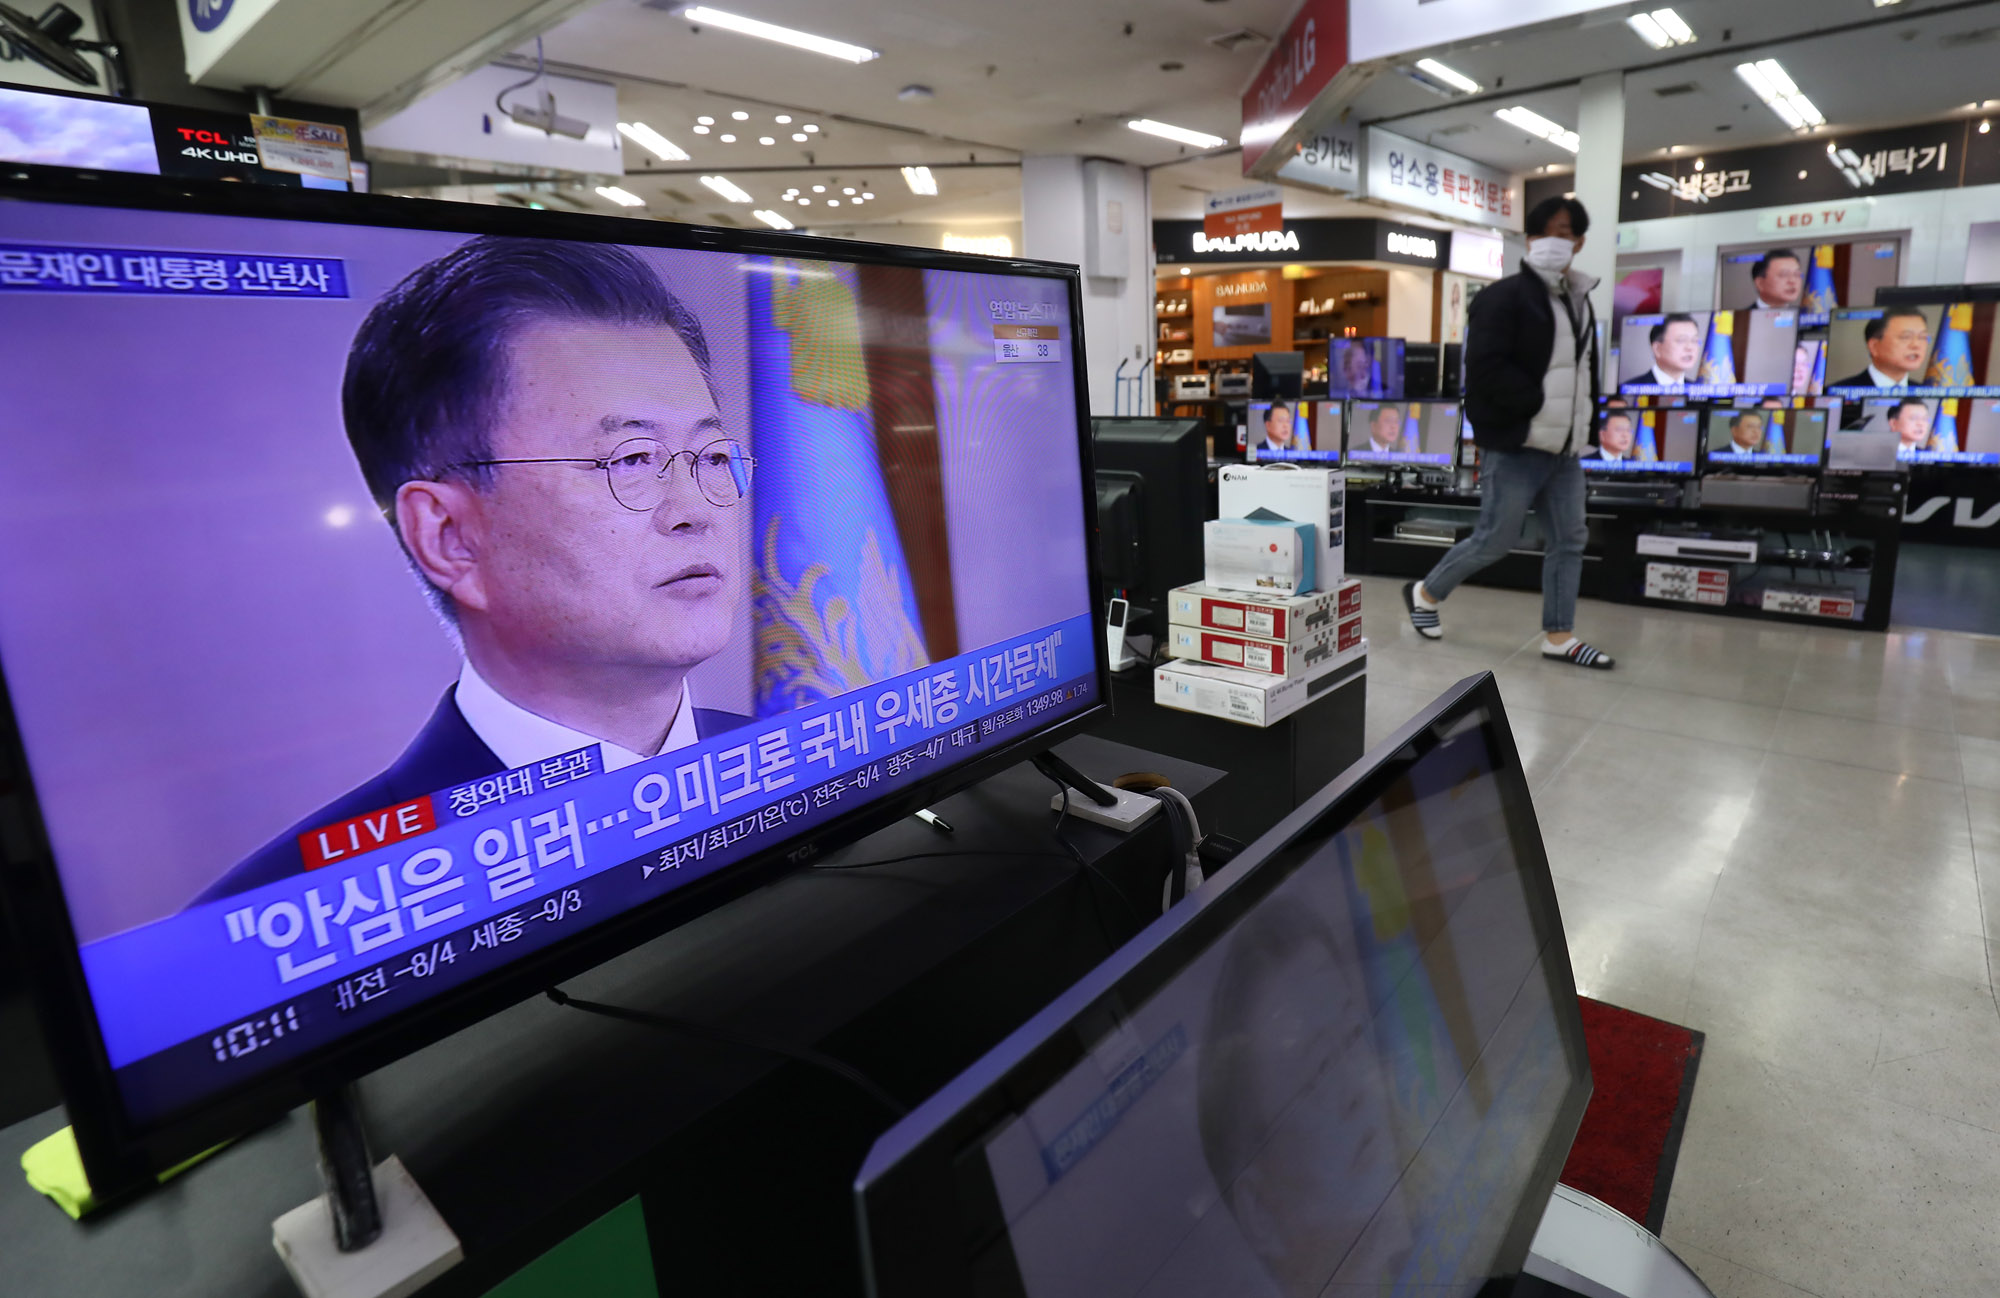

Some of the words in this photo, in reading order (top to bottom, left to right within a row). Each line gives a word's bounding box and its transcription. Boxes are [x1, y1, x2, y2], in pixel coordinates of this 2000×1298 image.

[177, 128, 229, 145] TCL
[181, 147, 213, 160] 4K
[214, 149, 259, 164] UHD
[1858, 142, 1947, 178] 세탁기
[1679, 169, 1752, 200] 냉장고
[1777, 212, 1813, 228] LED
[1822, 209, 1846, 224] TV
[1193, 231, 1300, 253] BALMUDA
[0, 252, 120, 287] 문재인
[122, 256, 229, 291] 대통령
[234, 261, 330, 293] 신년사
[1215, 281, 1268, 298] BALMUDA
[989, 299, 1059, 320] 연합뉴스TV
[1003, 343, 1019, 358] 울산
[1037, 344, 1049, 357] 38
[800, 699, 871, 770] 국내
[874, 669, 961, 745] 우세종
[982, 706, 1024, 736] 원/유로화
[1026, 689, 1064, 717] 1349.98
[448, 767, 535, 819] 청와대
[539, 750, 592, 790] 본관
[318, 803, 423, 860] LIVE
[469, 911, 525, 953] 세종
[811, 777, 848, 811] 전주
[885, 749, 917, 778] 광주
[950, 722, 978, 749] 대구
[787, 843, 818, 864] TCL
[212, 1004, 300, 1063] 10:11
